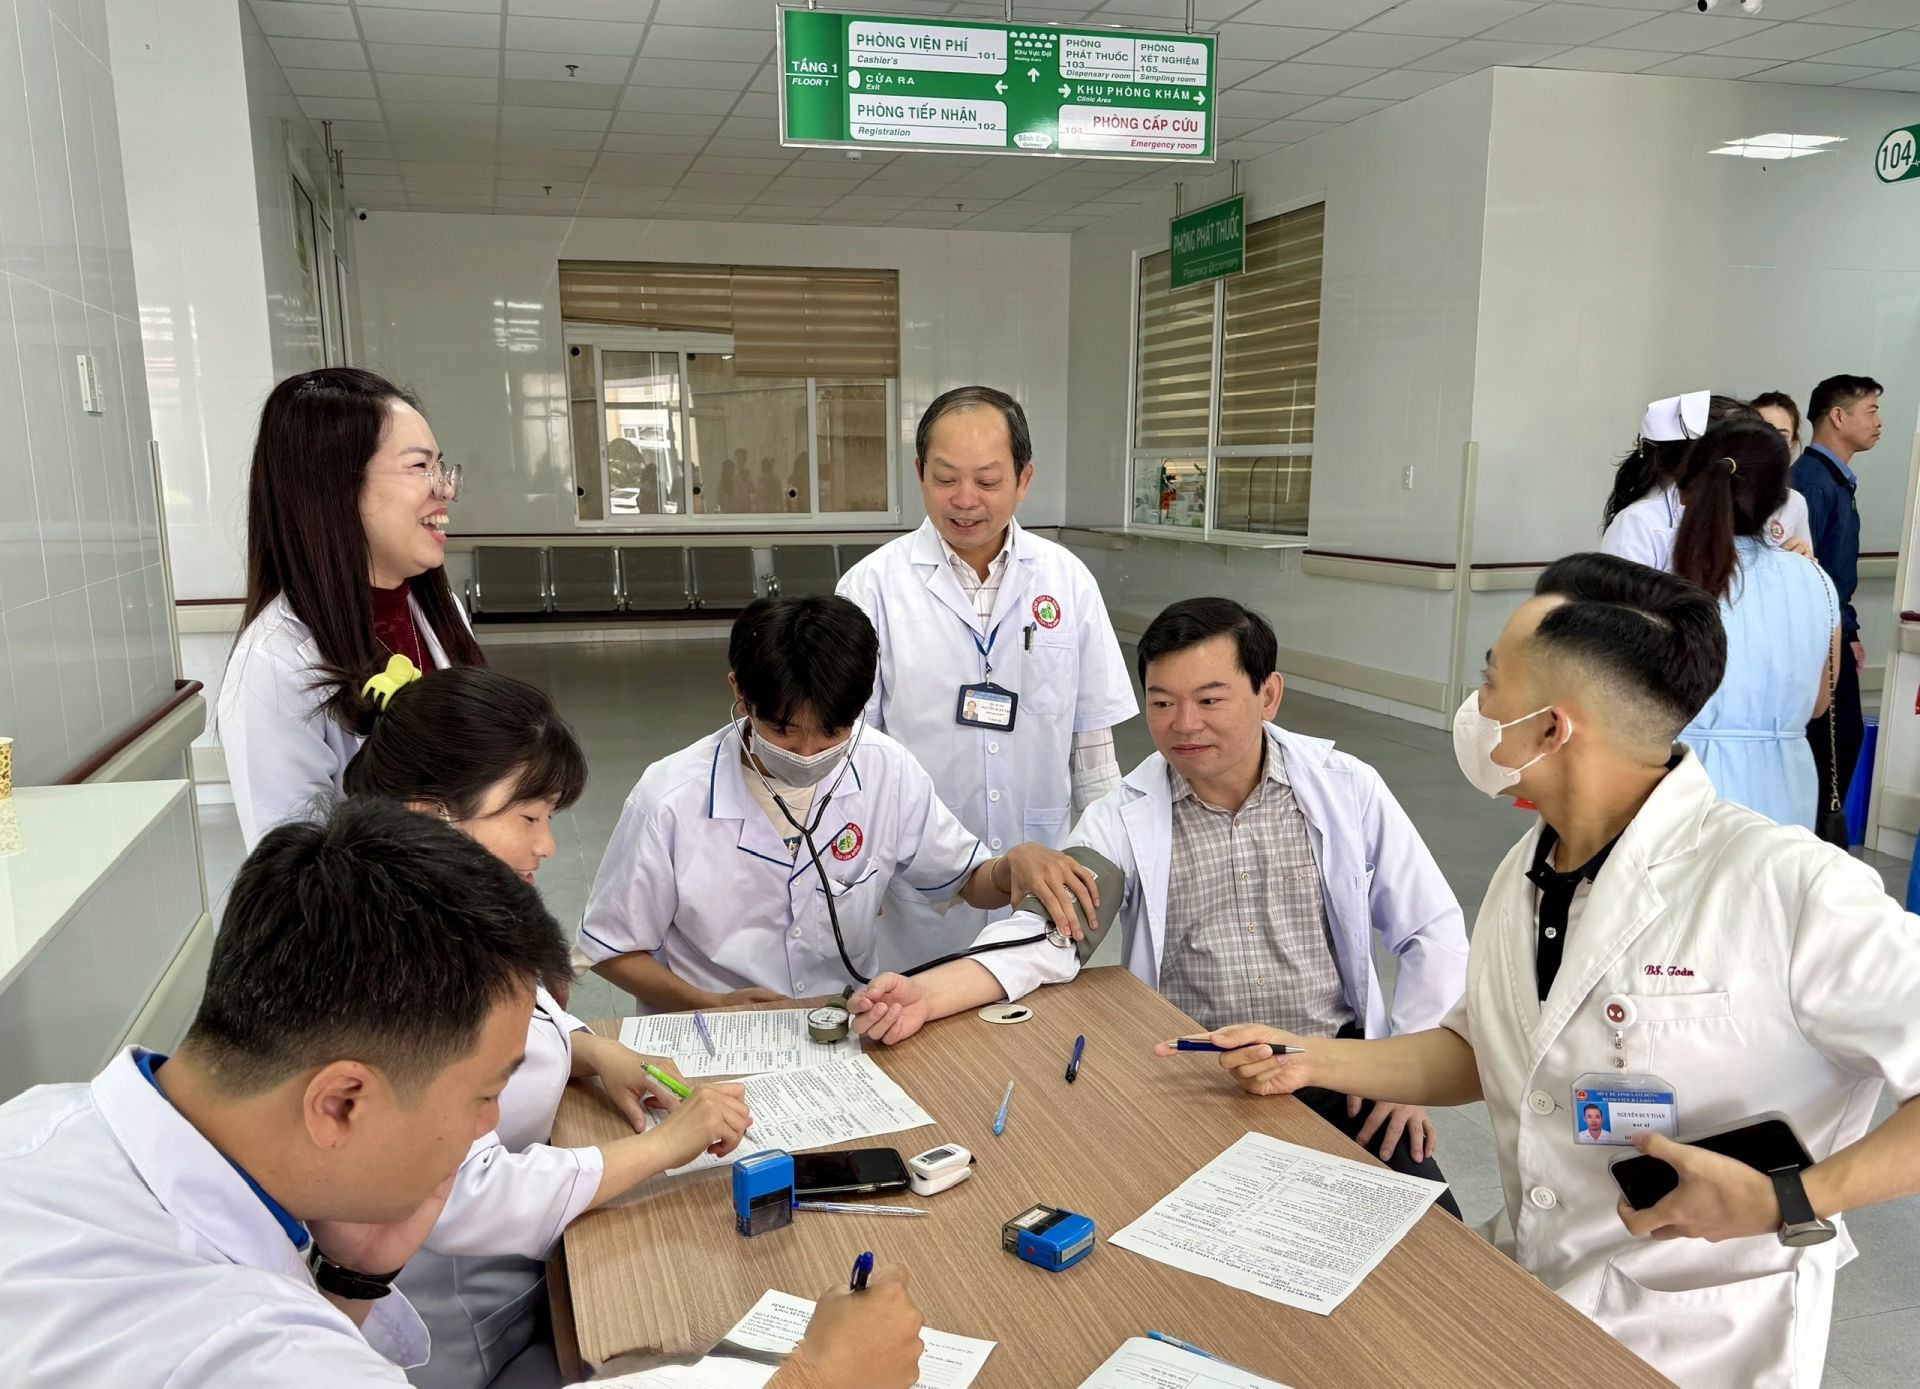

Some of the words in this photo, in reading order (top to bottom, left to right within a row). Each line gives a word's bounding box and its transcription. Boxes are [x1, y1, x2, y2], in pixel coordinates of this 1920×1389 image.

[856, 32, 905, 48] PHÒNG
[910, 36, 941, 52] VIỆN
[946, 37, 968, 52] PHÍ
[1066, 39, 1101, 48] PHÒNG
[1141, 43, 1175, 52] PHÒNG
[857, 55, 898, 65] Cashier's
[978, 52, 996, 60] 101
[1066, 50, 1092, 60] PHÁT
[1094, 50, 1129, 61] THUỐC
[1140, 53, 1160, 63] XÉT
[1162, 54, 1199, 66] NGHIỆM
[831, 63, 837, 73] 1
[866, 73, 893, 84] CỬA
[898, 76, 915, 85] RA
[1066, 69, 1109, 79] Dispensary
[1112, 72, 1131, 80] room
[1140, 74, 1174, 84] Sampling
[792, 78, 822, 86] FLOOR
[1077, 85, 1103, 95] KHU
[1107, 84, 1151, 98] PHÒNG
[1155, 87, 1190, 100] KHÁM
[857, 102, 904, 118] PHÒNG
[908, 103, 936, 120] TIẾP
[941, 106, 977, 124] NHẬN
[1093, 113, 1139, 130] PHÒNG
[1143, 115, 1168, 131] CẤP
[1172, 117, 1198, 132] CỨU
[858, 126, 910, 137] Registration
[1065, 127, 1083, 135] 104
[1131, 139, 1174, 150] Emergency
[1882, 140, 1911, 170] 104
[1174, 228, 1195, 255] PHÒNG
[1196, 219, 1214, 249] PHÁT
[1216, 207, 1239, 243] THUỐC
[1644, 965, 1663, 975] BS.
